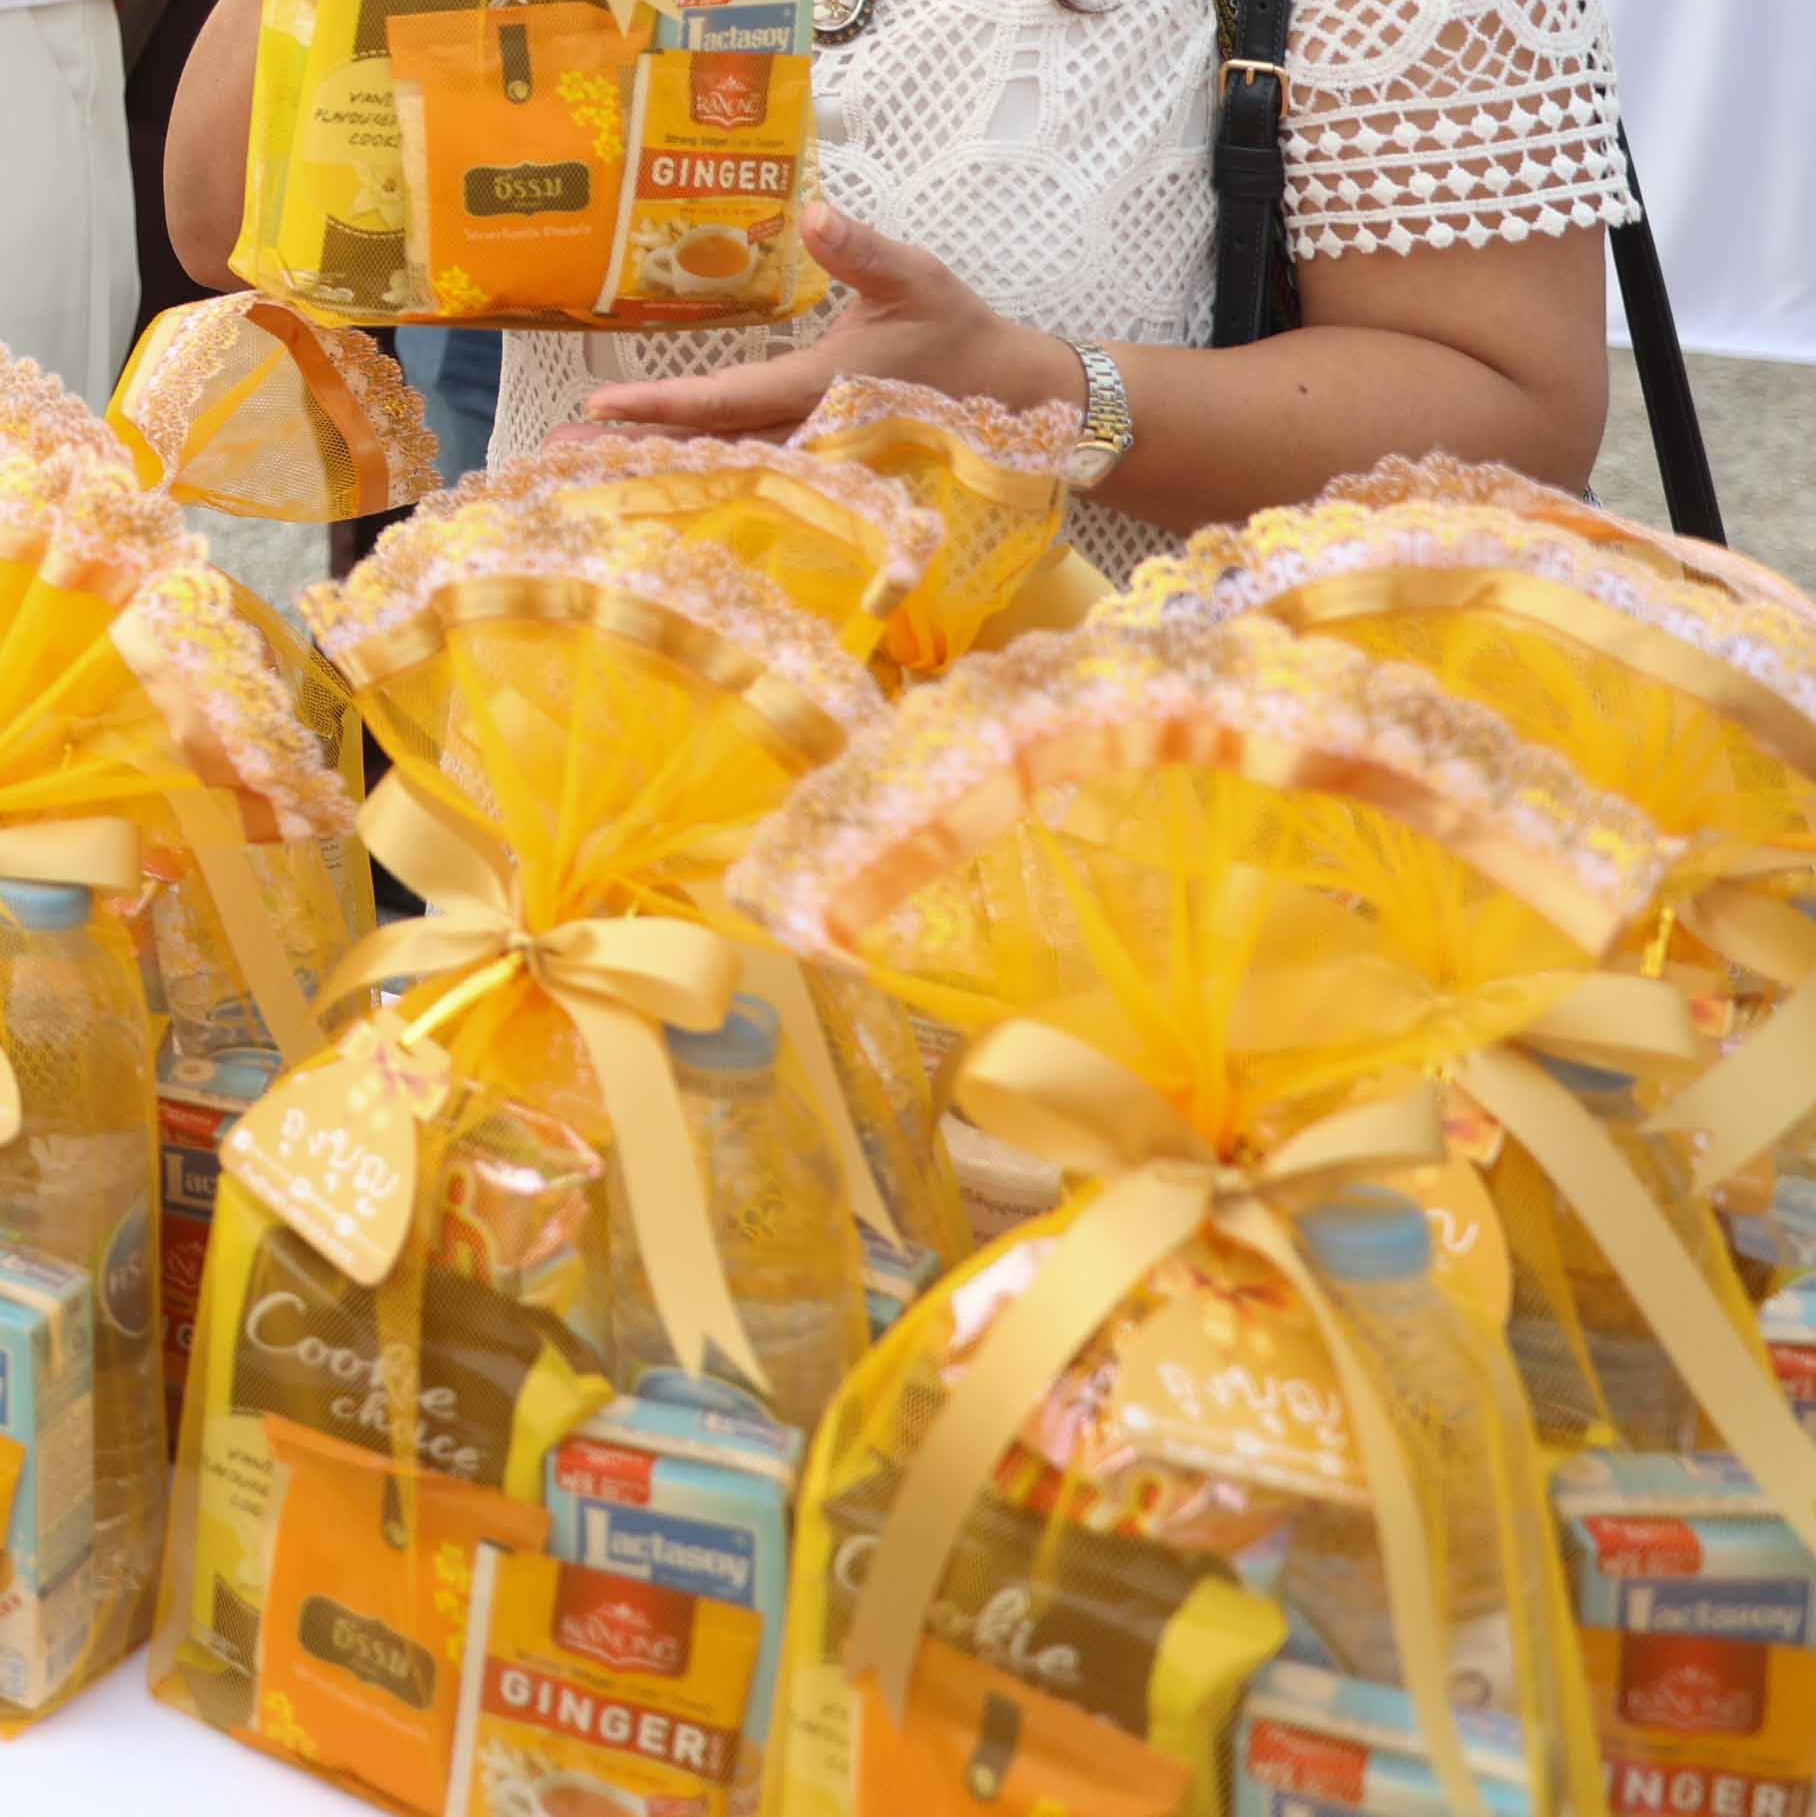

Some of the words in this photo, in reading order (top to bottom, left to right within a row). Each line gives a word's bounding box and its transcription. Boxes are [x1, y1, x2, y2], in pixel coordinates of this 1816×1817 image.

[688, 16, 791, 54] Lactasoy
[651, 156, 780, 191] GINGER
[584, 1506, 751, 1589] Lactasoy
[498, 1669, 708, 1768] GINGER
